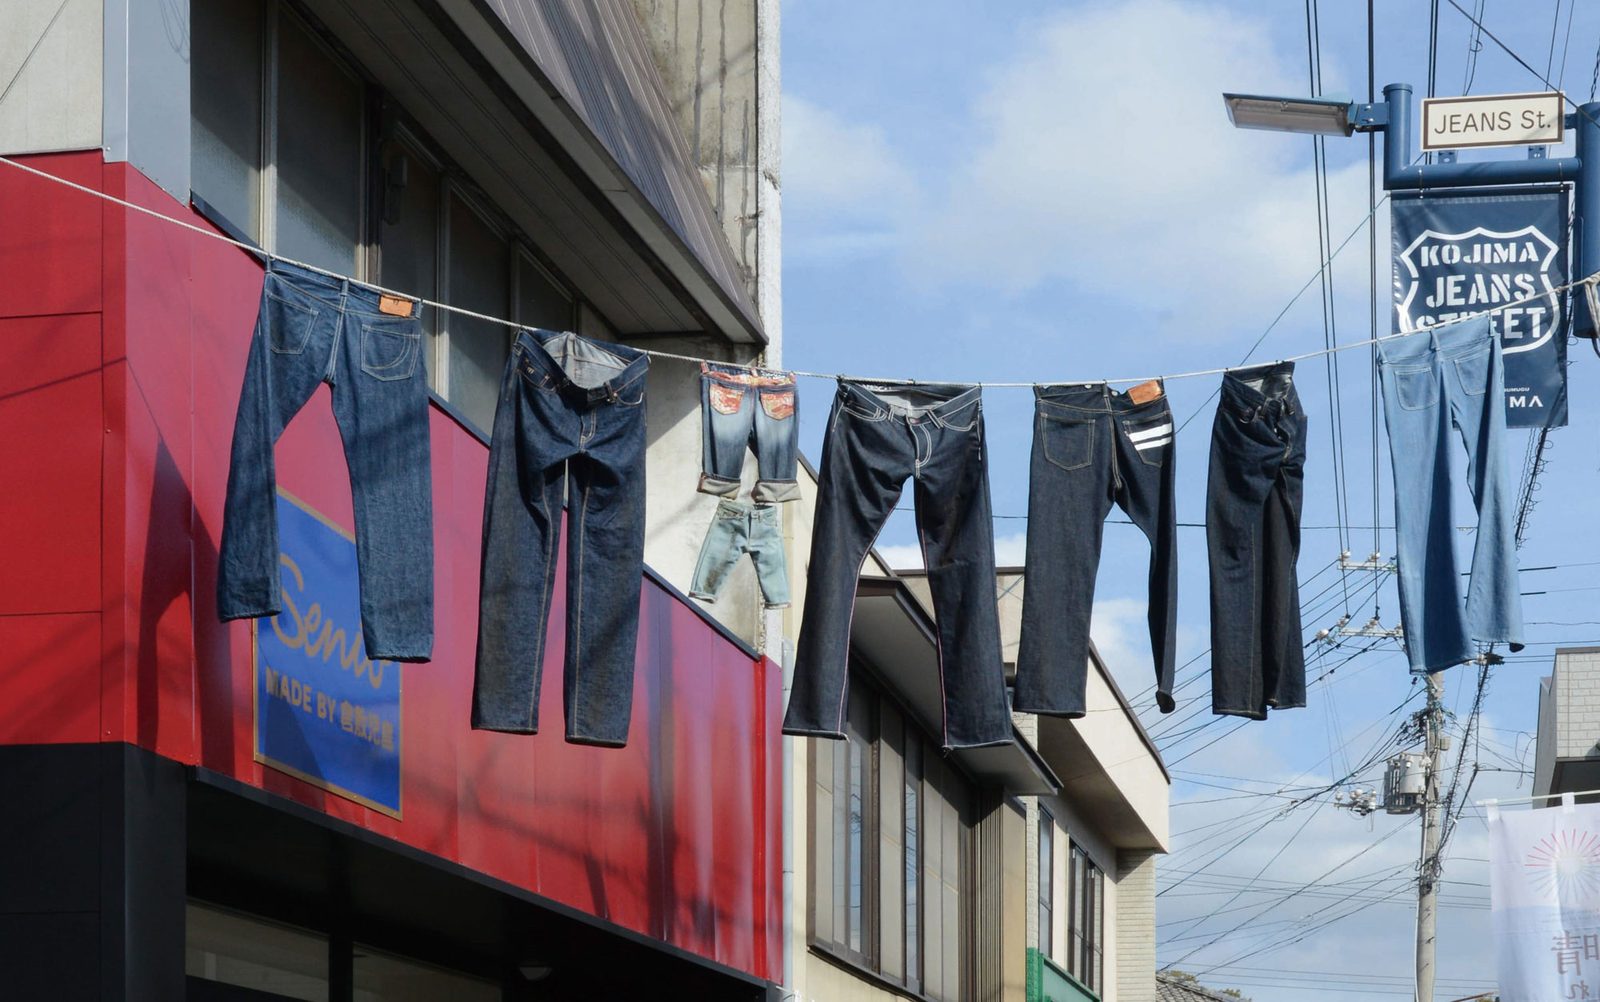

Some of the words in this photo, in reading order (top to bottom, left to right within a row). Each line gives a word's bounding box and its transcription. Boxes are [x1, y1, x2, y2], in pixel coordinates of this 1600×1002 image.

[1434, 112, 1511, 135] JEANS
[1521, 110, 1551, 129] St.
[1420, 242, 1539, 267] KOJIMA
[1425, 273, 1536, 307] JEANS
[266, 665, 312, 714] MADE
[317, 691, 336, 723] BY
